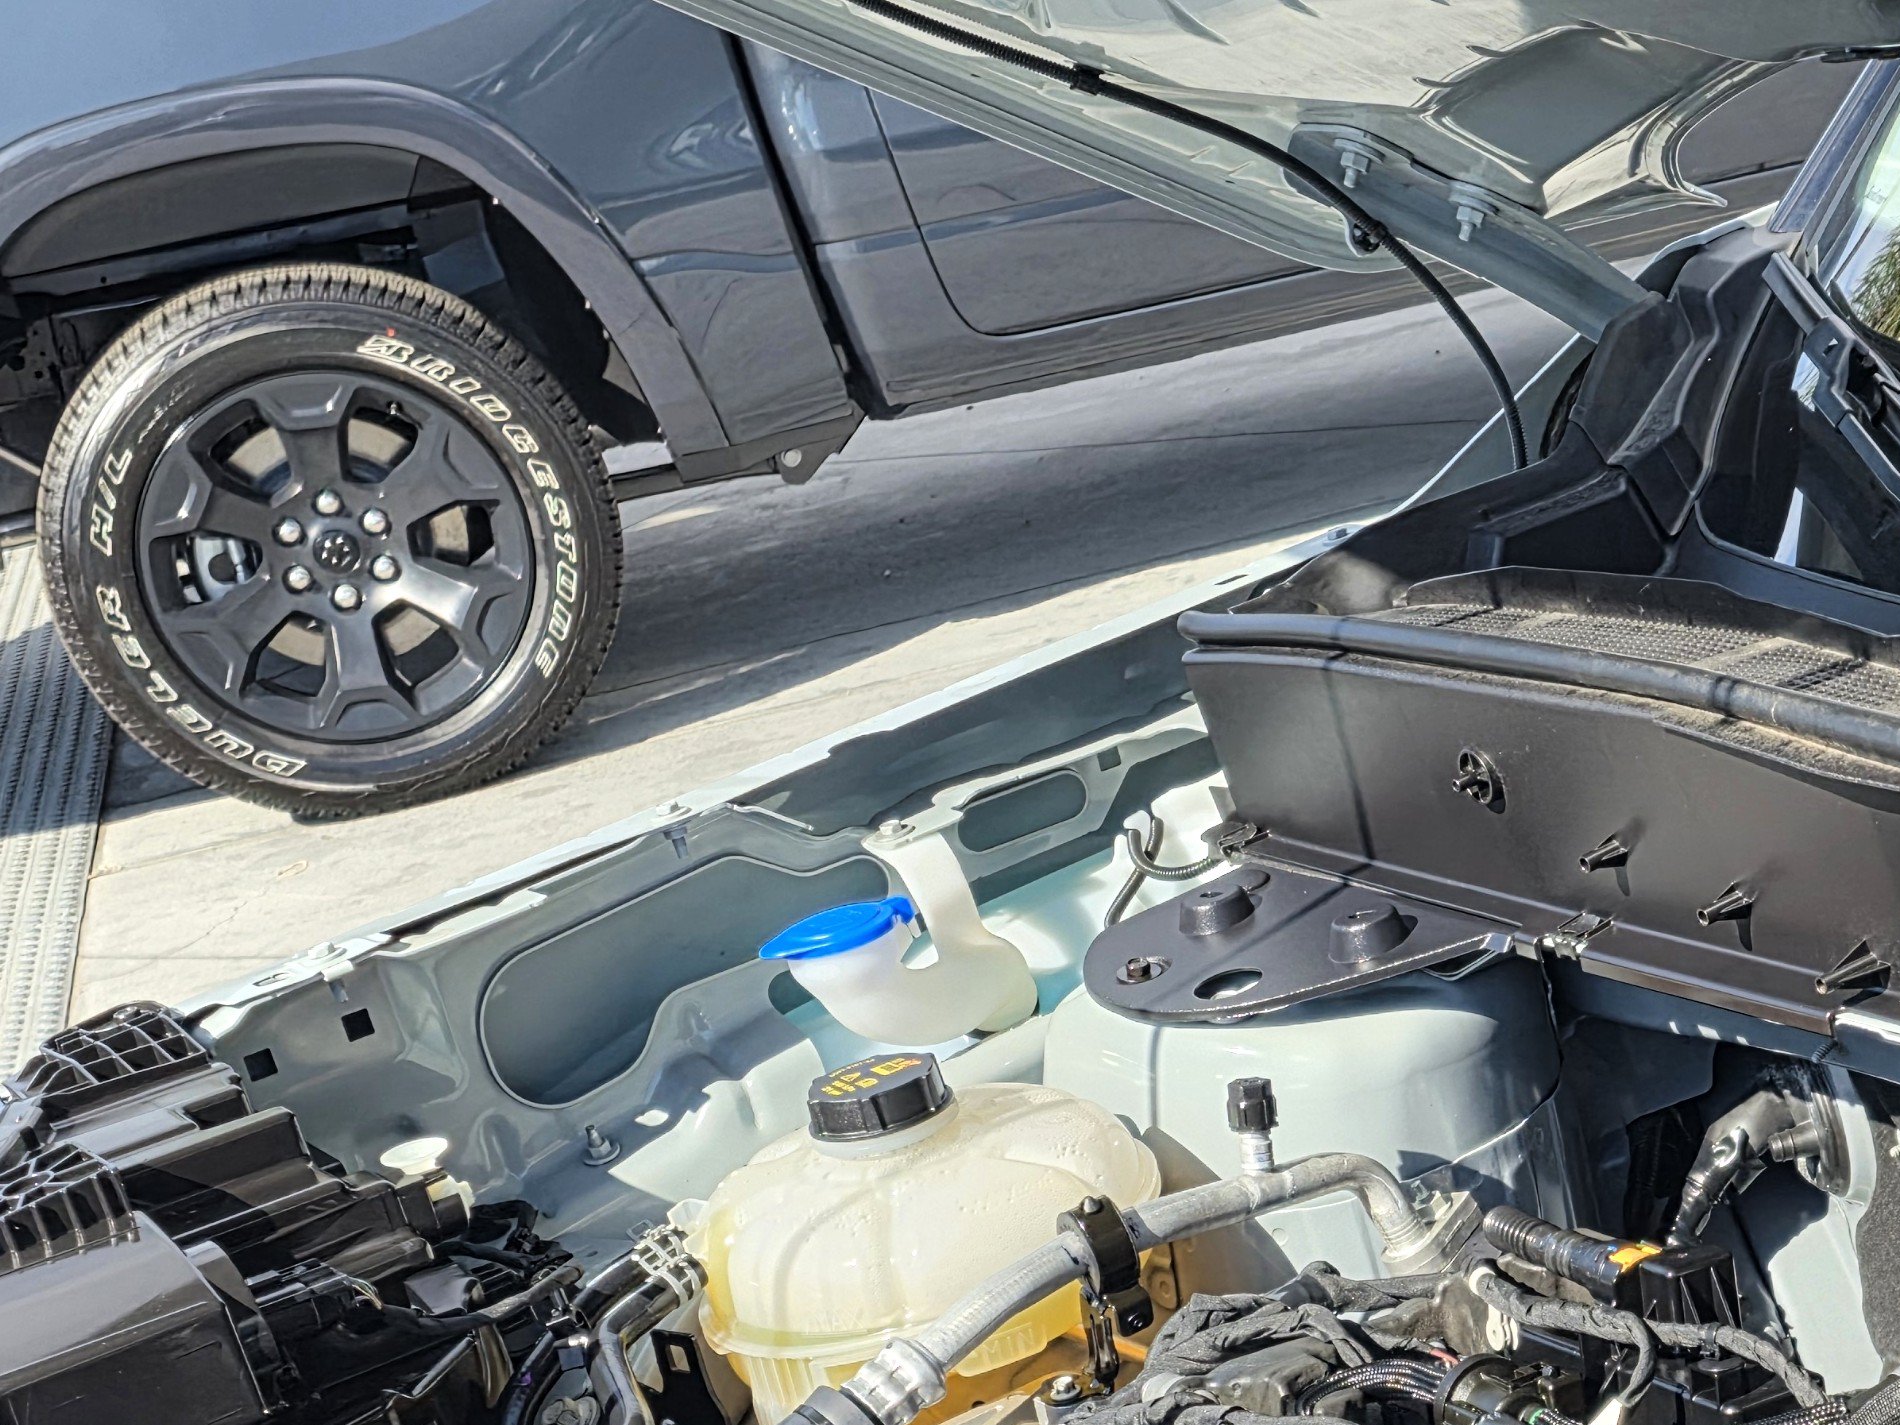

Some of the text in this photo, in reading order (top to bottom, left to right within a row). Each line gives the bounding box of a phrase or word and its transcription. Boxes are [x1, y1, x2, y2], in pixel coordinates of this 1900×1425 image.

[89, 448, 309, 778] DUELER H/L
[356, 335, 580, 677] BRIDGESTONE
[980, 1328, 1036, 1362] MIN
